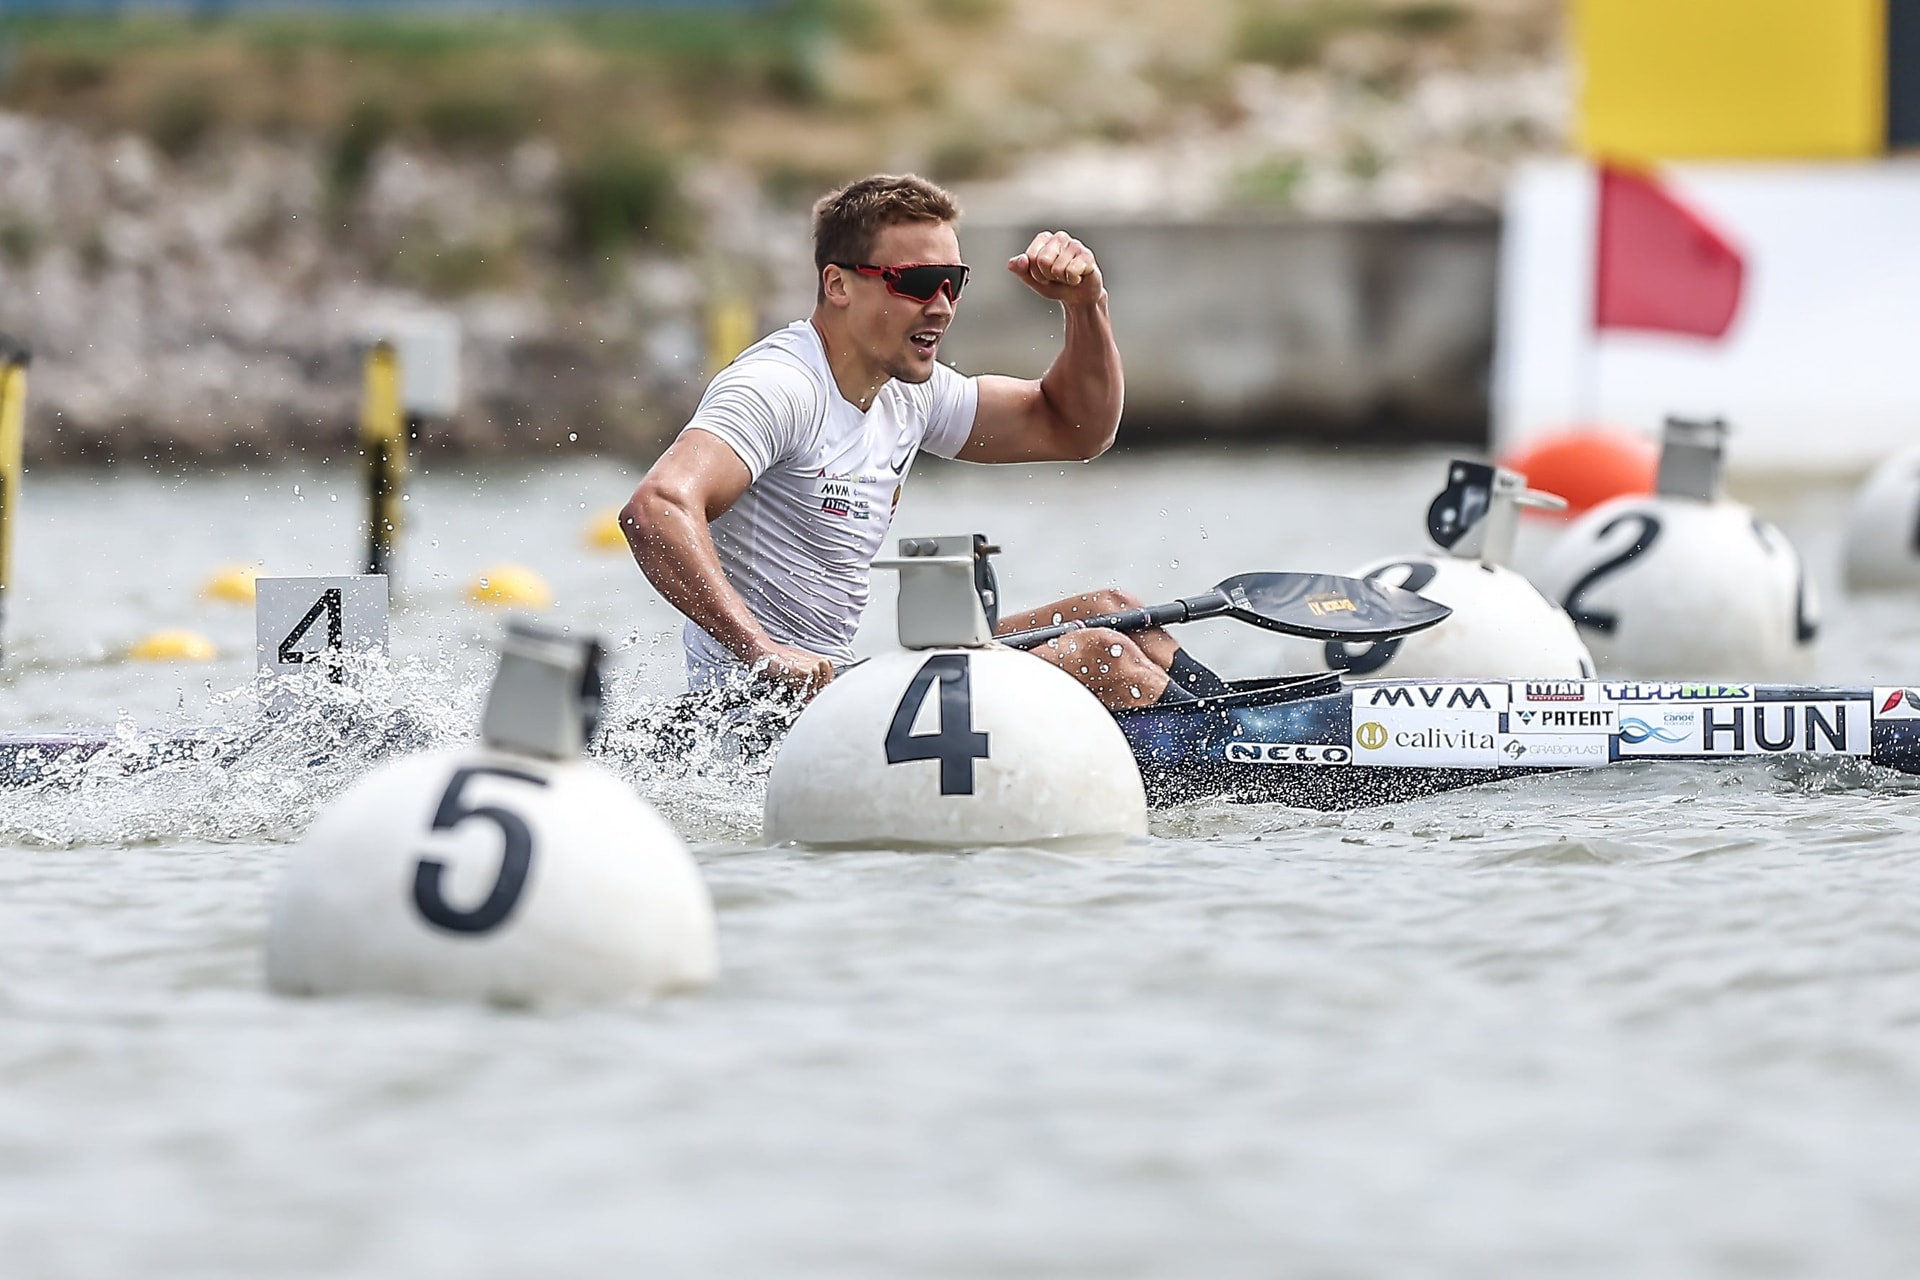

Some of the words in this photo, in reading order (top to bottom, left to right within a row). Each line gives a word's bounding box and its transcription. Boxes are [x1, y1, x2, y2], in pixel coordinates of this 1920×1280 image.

[821, 483, 850, 497] MVM
[1564, 511, 1662, 637] 2
[277, 587, 343, 685] 4
[1370, 687, 1491, 708] MVM
[884, 653, 990, 796] 4
[1542, 711, 1614, 726] PATENT
[1703, 706, 1847, 752] HUN
[1395, 728, 1495, 750] calivita
[1529, 745, 1604, 754] GRABOPLAST
[1228, 745, 1348, 763] NELO
[412, 766, 551, 934] 5
